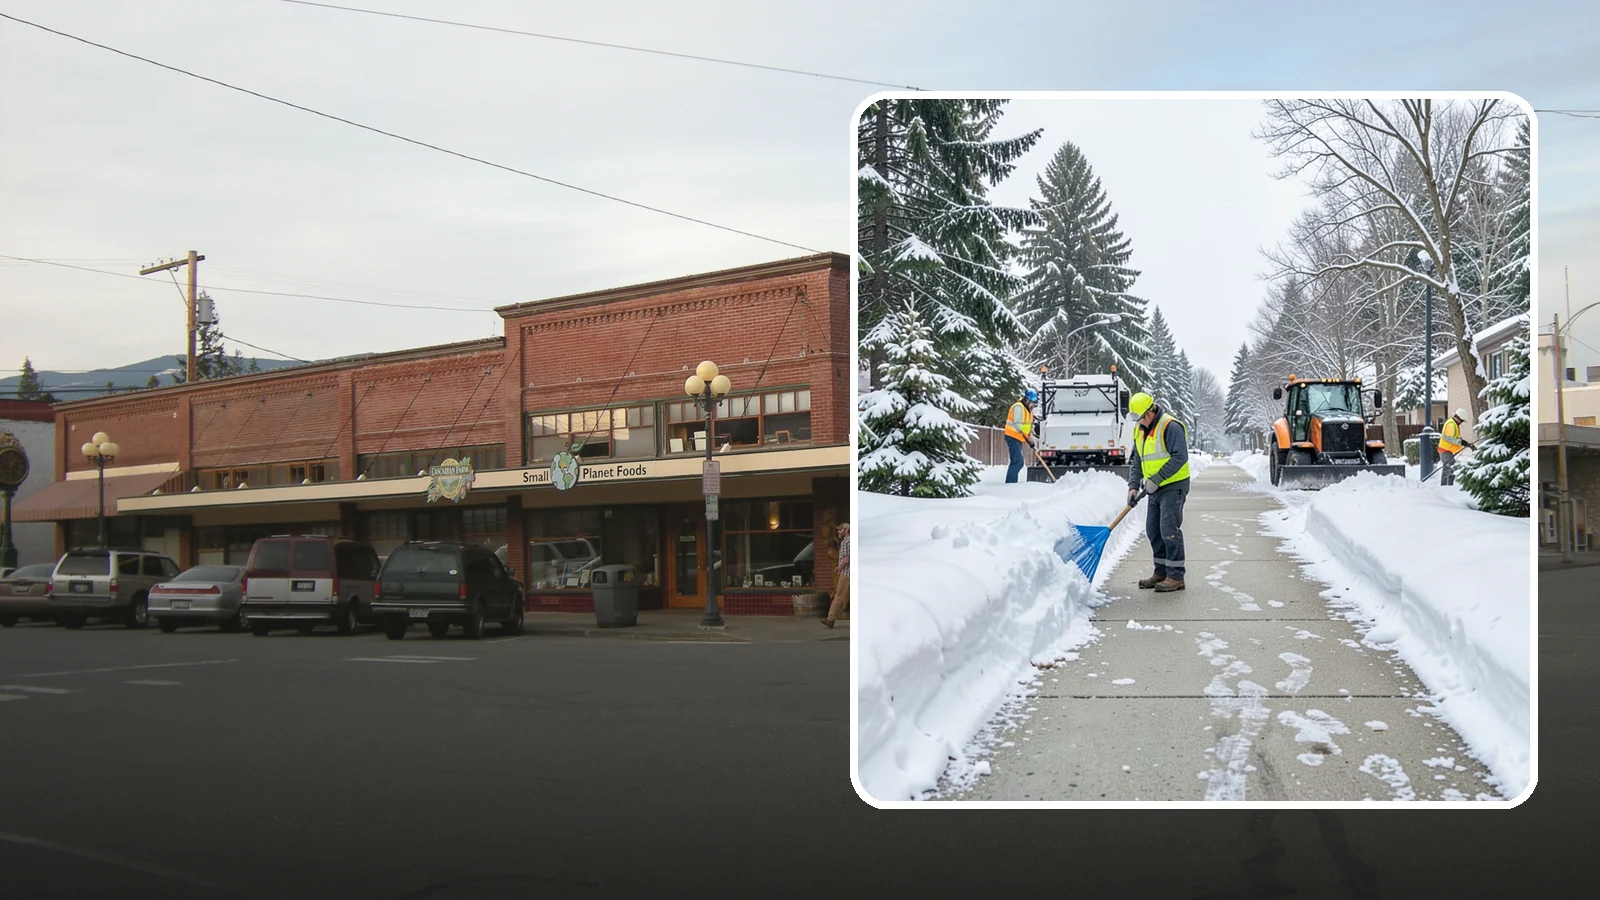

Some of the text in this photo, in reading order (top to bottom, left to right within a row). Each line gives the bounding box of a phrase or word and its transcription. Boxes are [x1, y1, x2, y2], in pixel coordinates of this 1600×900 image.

[523, 464, 647, 482] Small Planet Foods
